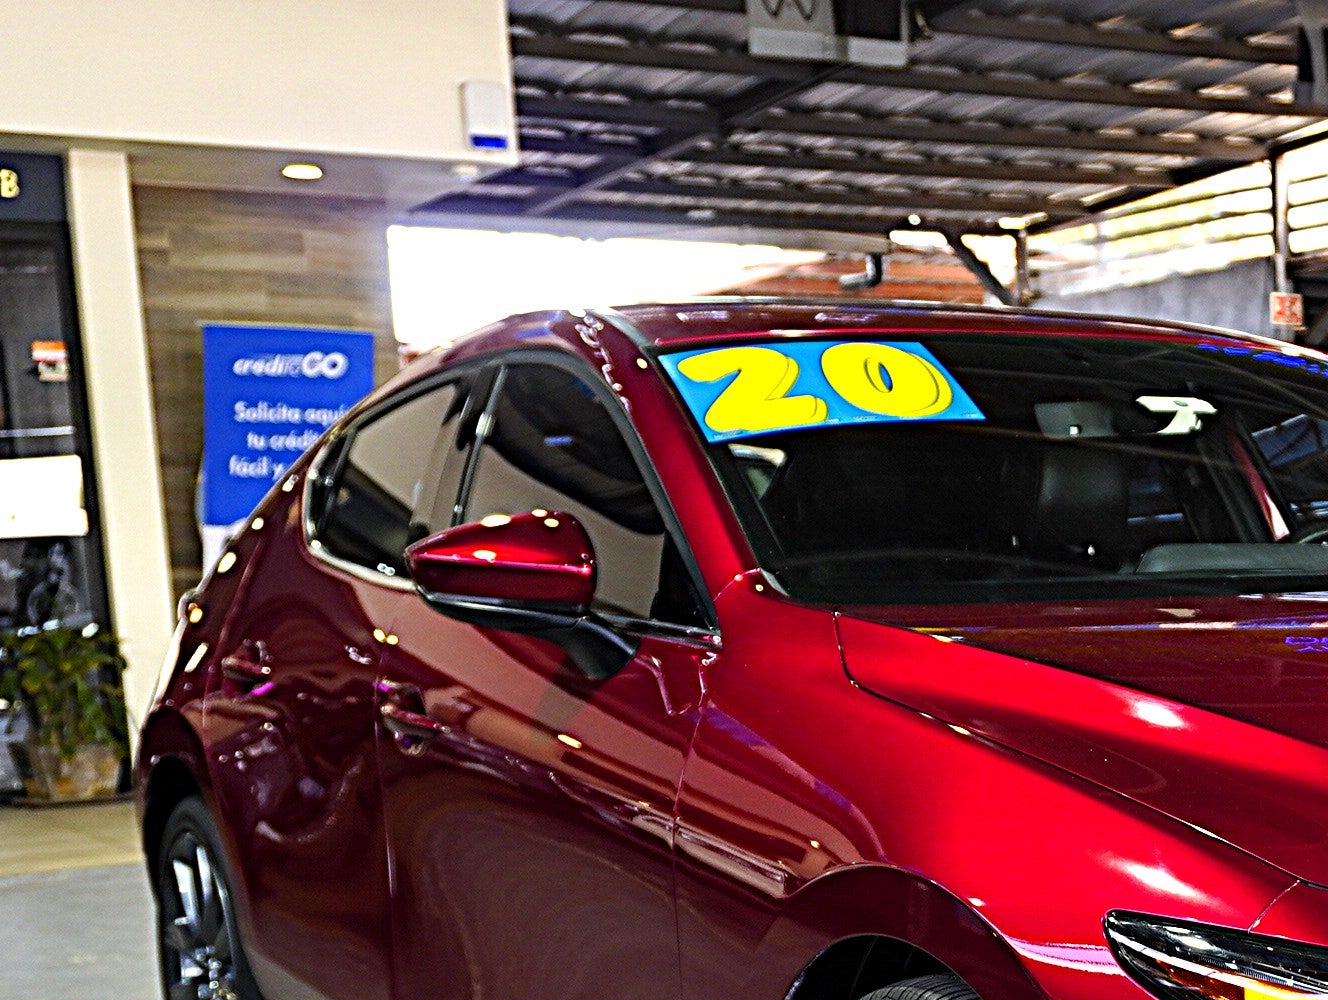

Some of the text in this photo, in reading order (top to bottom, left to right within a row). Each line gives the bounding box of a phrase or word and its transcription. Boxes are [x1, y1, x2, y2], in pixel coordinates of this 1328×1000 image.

[677, 342, 953, 431] 20
[235, 401, 301, 424] Solicita
[247, 432, 269, 451] tu
[230, 454, 271, 478] fácil
